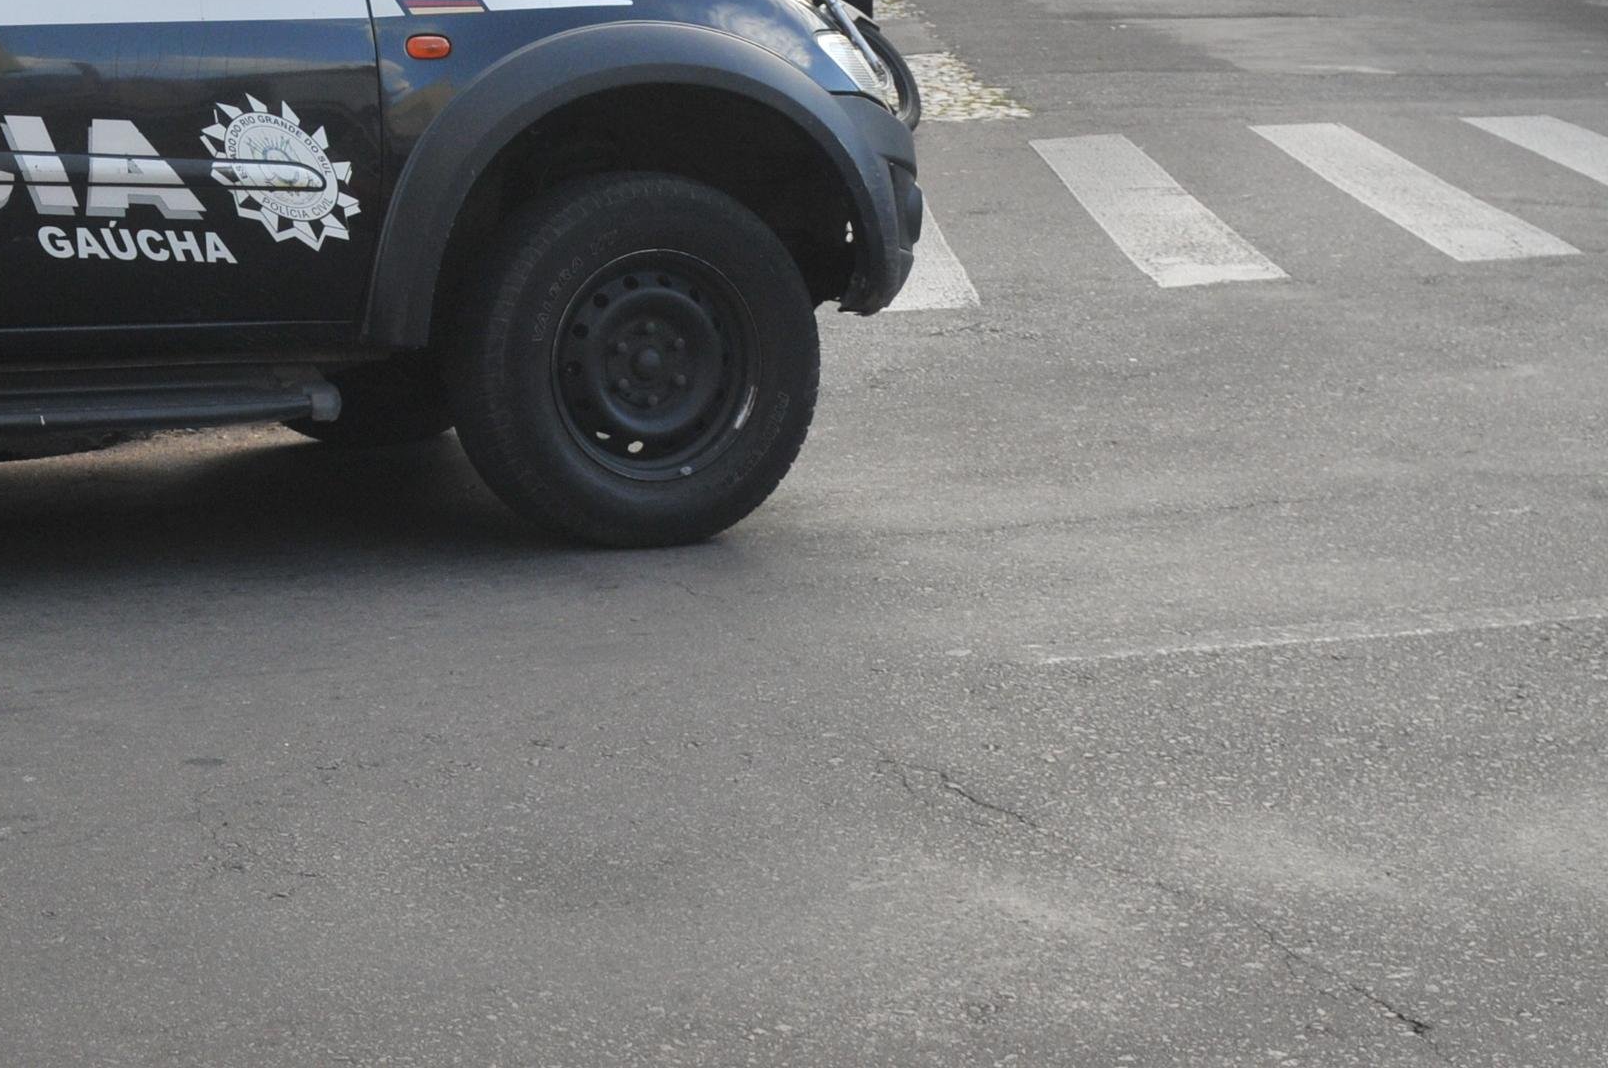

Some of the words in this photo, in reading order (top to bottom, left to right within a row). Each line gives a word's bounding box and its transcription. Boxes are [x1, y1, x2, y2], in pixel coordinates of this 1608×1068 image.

[240, 115, 256, 129] RIO
[257, 114, 303, 138] GRANDE
[304, 138, 320, 153] DO
[317, 155, 333, 176] SUL
[261, 196, 311, 219] POLÍCIA
[311, 197, 334, 217] CIVIL
[37, 220, 239, 264] GAÚCHA
